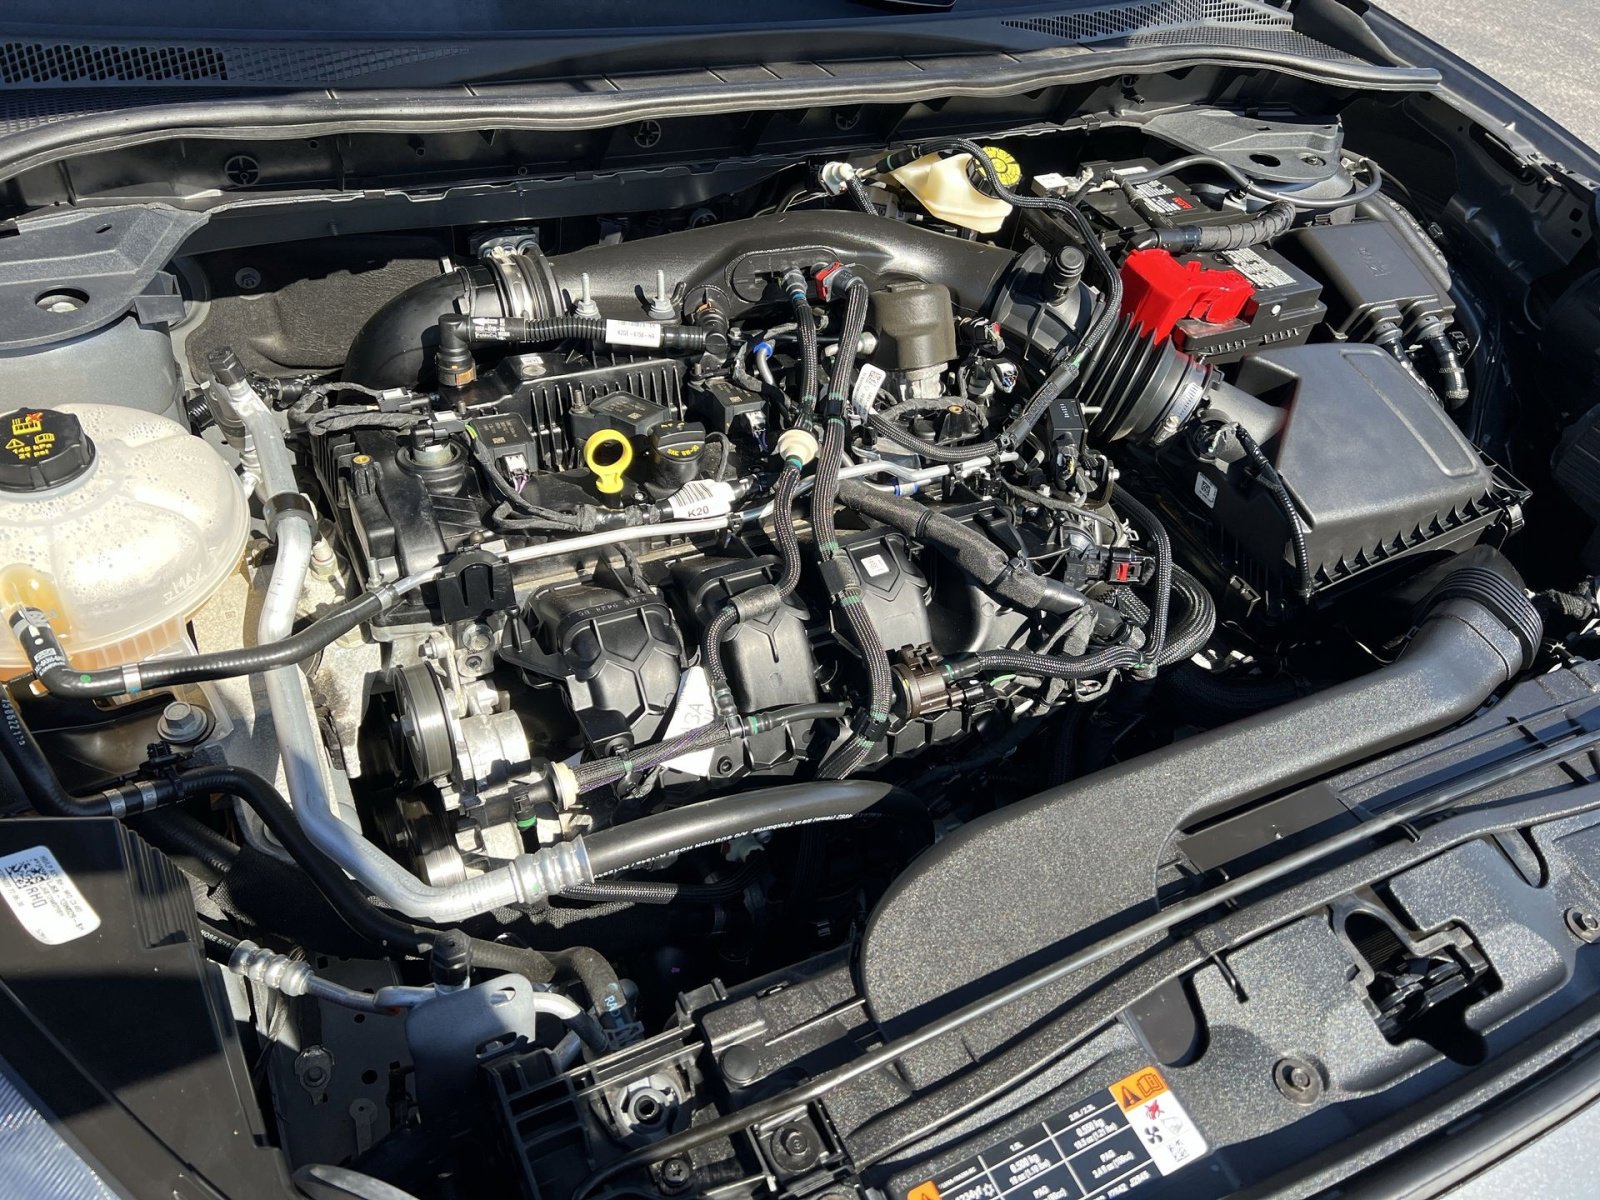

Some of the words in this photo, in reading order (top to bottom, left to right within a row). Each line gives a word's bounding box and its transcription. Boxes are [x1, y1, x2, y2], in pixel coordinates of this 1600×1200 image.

[34, 449, 50, 458] psi
[688, 506, 709, 518] K20
[695, 836, 732, 847] SUCTION
[669, 846, 692, 855] HOSE
[1092, 1118, 1107, 1131] kg
[1027, 1154, 1042, 1167] kg
[1100, 1150, 1116, 1162] PAG
[1032, 1185, 1049, 1199] PAG
